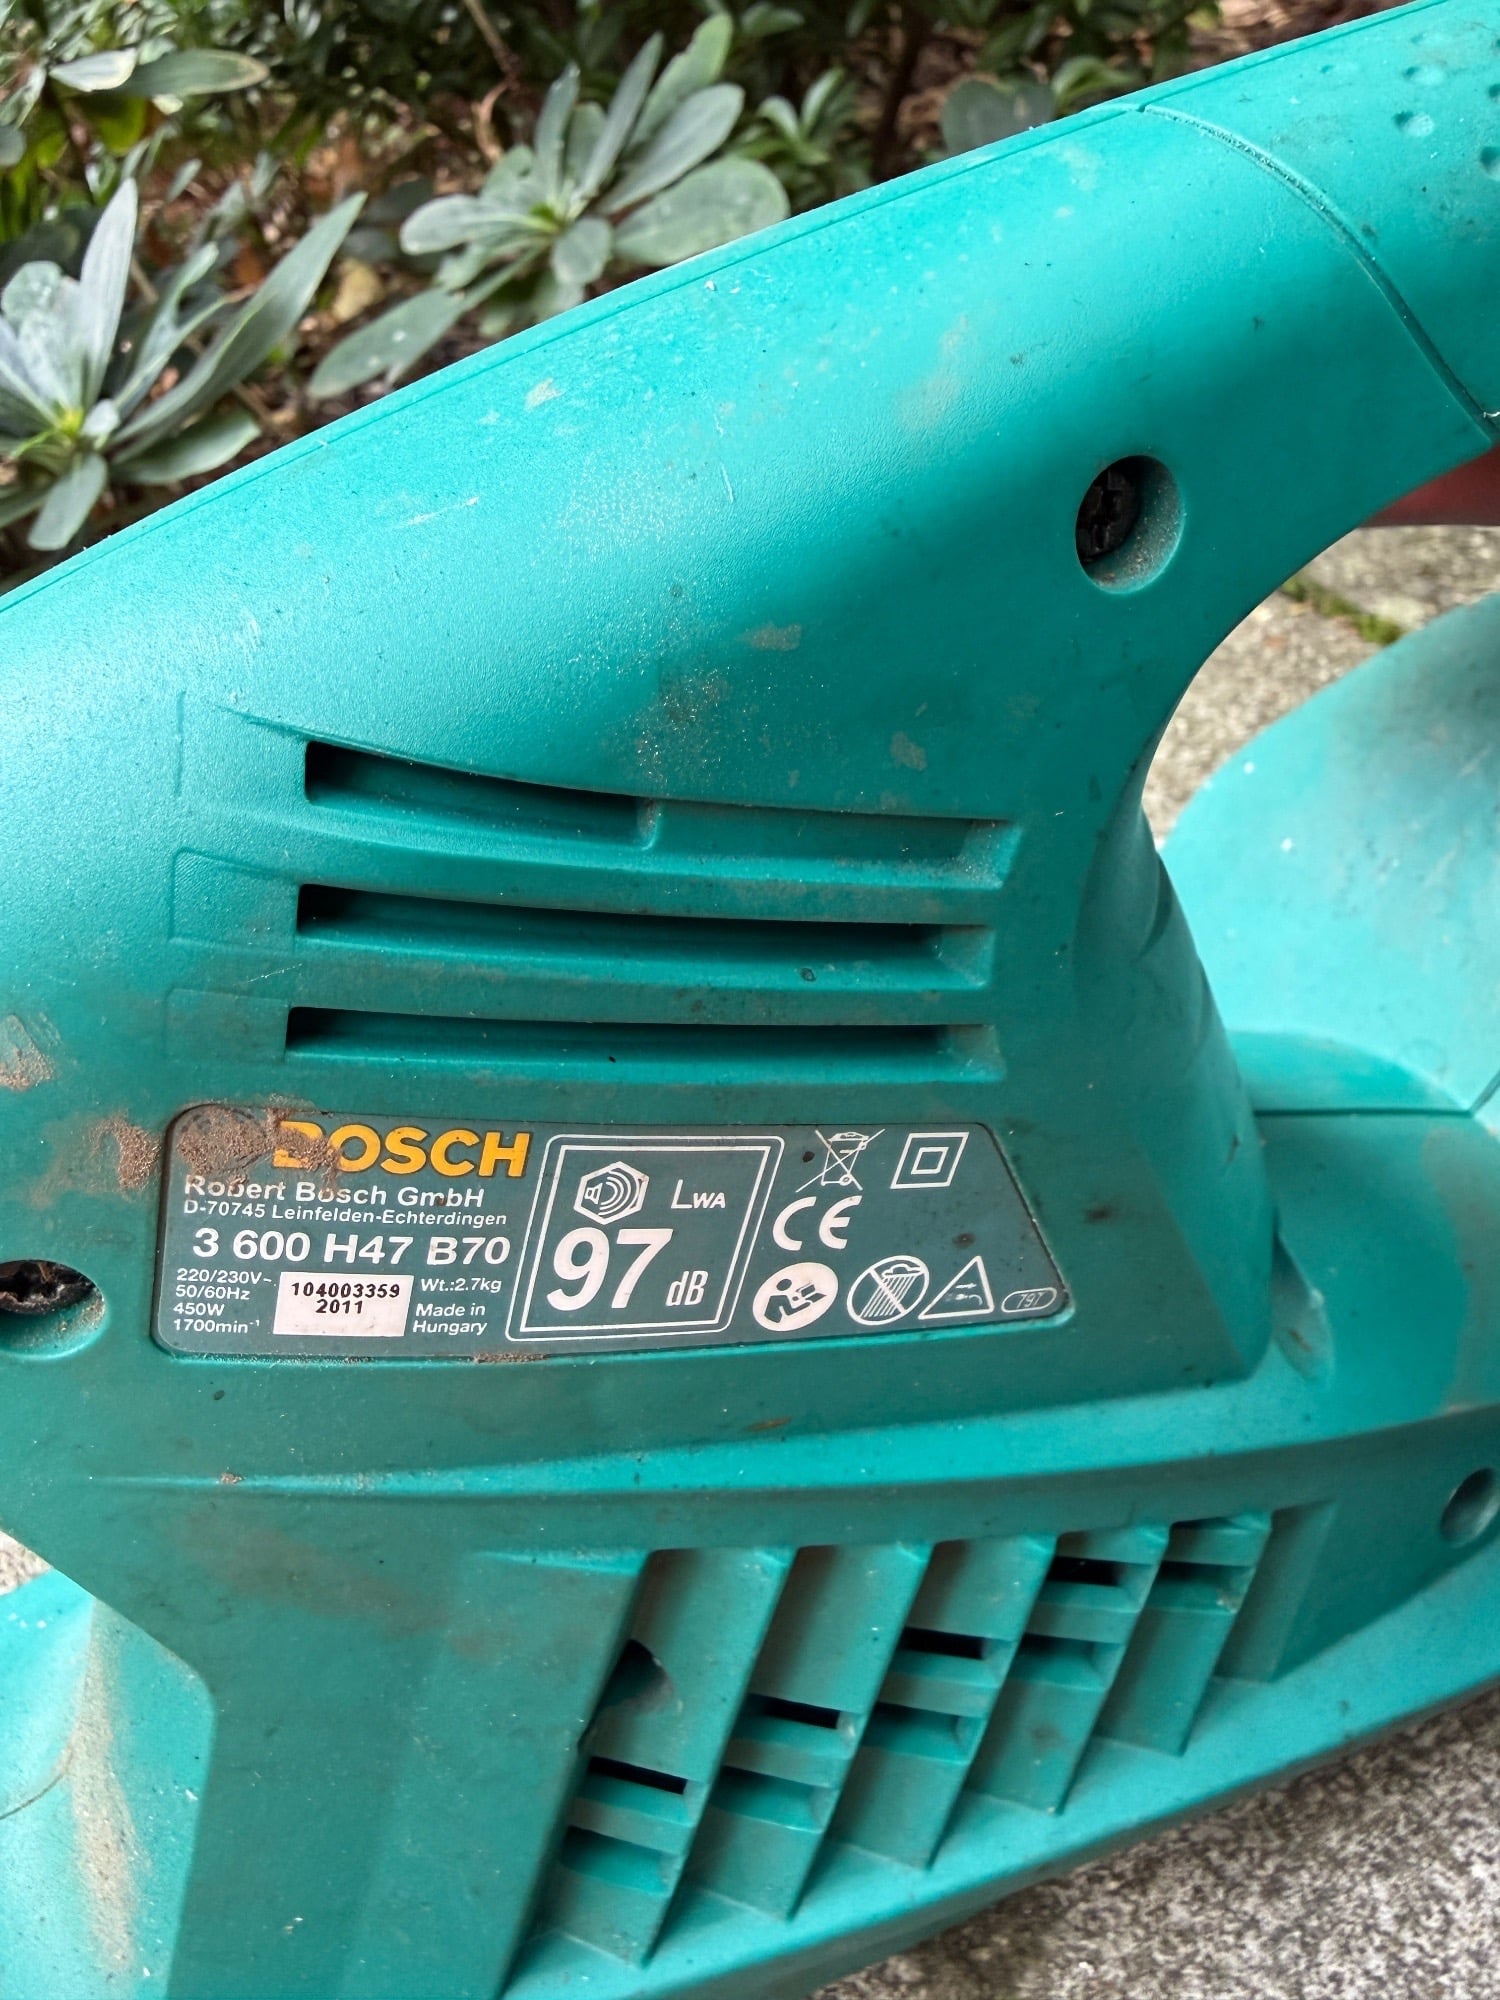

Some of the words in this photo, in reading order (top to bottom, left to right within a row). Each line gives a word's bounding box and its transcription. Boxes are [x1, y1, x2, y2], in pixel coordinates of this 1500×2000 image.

[184, 1174, 286, 1201] Robert
[295, 1182, 387, 1206] Bosch
[397, 1186, 485, 1208] GmbH
[183, 1199, 266, 1219] D-70745
[271, 1204, 507, 1229] Leinfelden-Echterdingen
[773, 1195, 862, 1251] CE
[192, 1228, 220, 1258] 3
[232, 1230, 311, 1262] 600
[323, 1233, 414, 1266] H47
[426, 1236, 511, 1266] B70
[546, 1227, 674, 1311] 97
[175, 1284, 250, 1301] 50/60Hz
[291, 1281, 401, 1299] 104003359
[665, 1270, 709, 1307] dB
[173, 1302, 225, 1317] 450W
[315, 1299, 364, 1315] 2011
[415, 1303, 466, 1318] Made
[470, 1302, 486, 1317] in
[412, 1320, 488, 1336] Hungary
